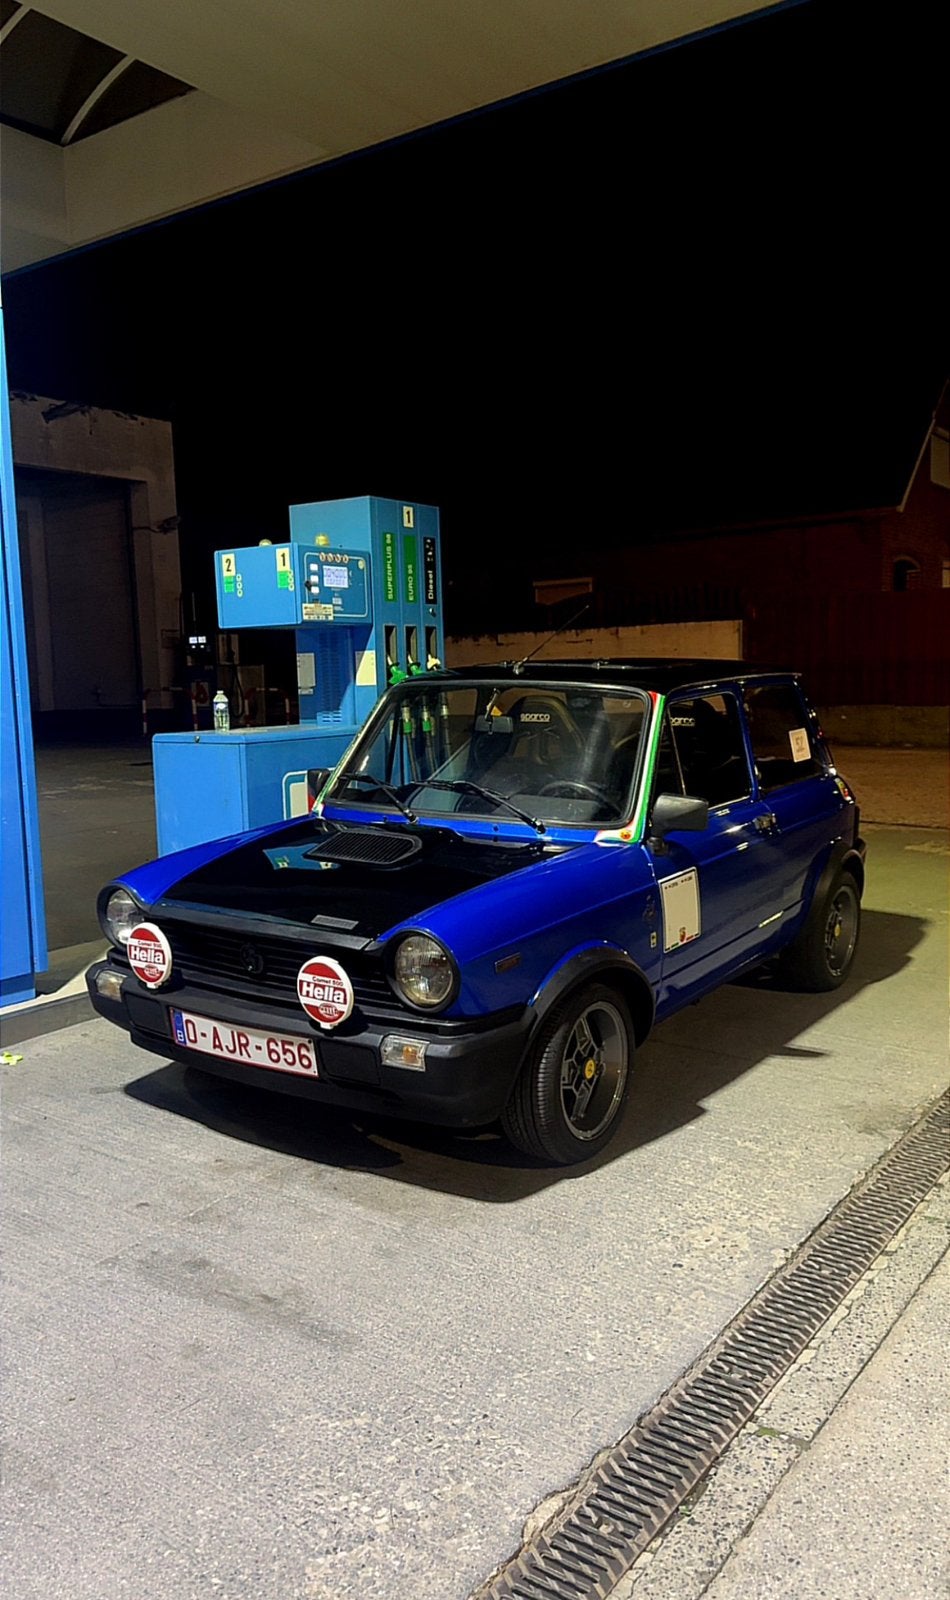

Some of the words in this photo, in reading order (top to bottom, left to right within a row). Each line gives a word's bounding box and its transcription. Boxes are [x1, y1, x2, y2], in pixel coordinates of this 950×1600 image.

[405, 509, 412, 525] 1
[225, 558, 232, 572] 2
[280, 552, 286, 567] 1
[385, 546, 394, 600] SUPERPLUS
[407, 576, 415, 601] EURO
[130, 945, 164, 964] Hella
[301, 981, 345, 1004] Hella
